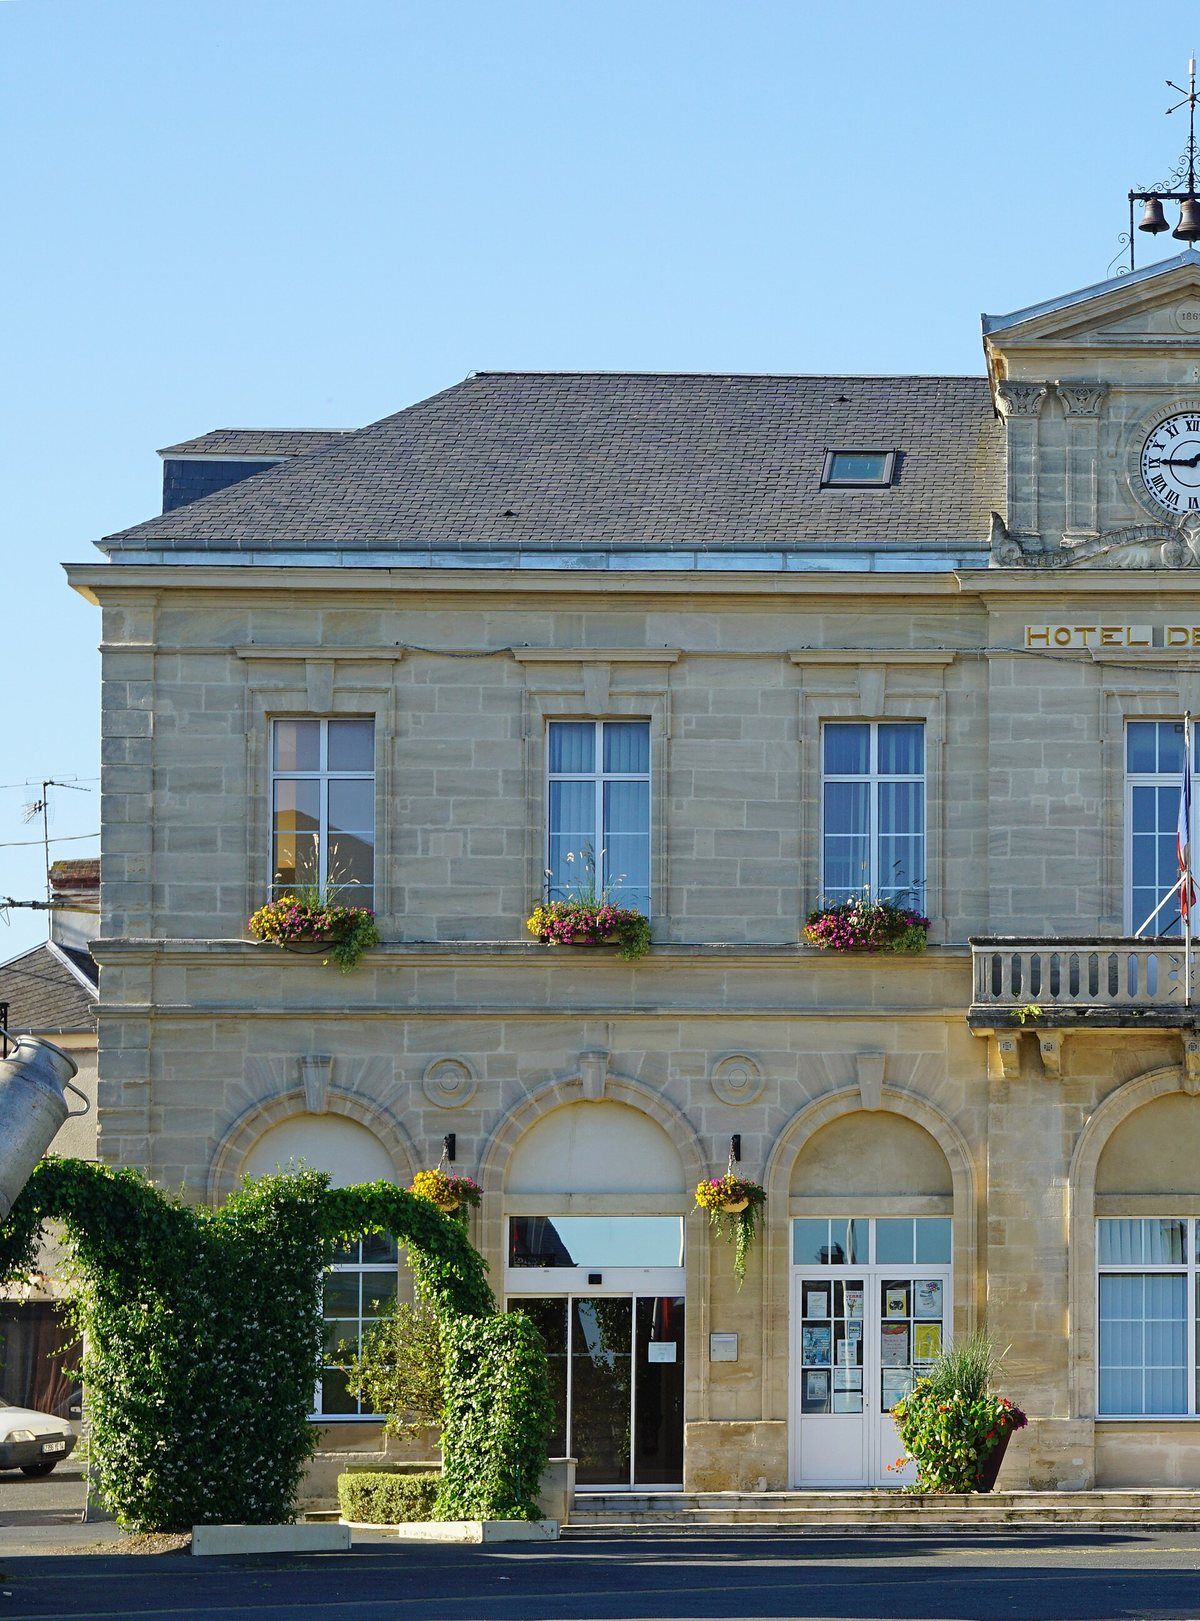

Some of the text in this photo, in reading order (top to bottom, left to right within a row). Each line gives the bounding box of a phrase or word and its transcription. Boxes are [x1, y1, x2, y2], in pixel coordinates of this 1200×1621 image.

[1164, 424, 1180, 439] XI
[1186, 420, 1200, 432] XII
[1152, 440, 1166, 452] X
[1149, 457, 1161, 469] IX
[1151, 473, 1168, 494] VIII
[1164, 489, 1180, 505] VII
[1188, 497, 1199, 509] VI
[1027, 626, 1151, 647] HOTEL
